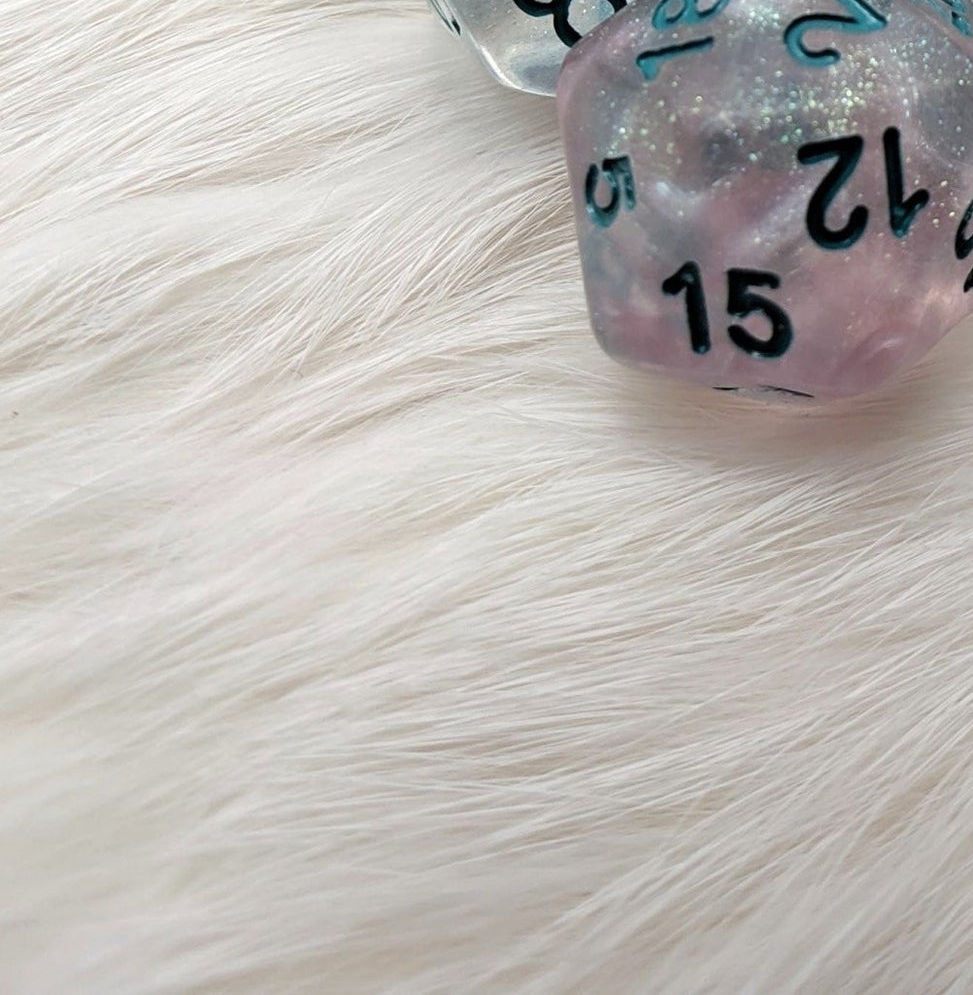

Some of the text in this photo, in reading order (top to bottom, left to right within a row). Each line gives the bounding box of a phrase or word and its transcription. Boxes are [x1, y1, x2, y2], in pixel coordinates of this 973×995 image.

[585, 155, 636, 229] 5
[797, 127, 930, 251] 12
[662, 261, 793, 358] 15
